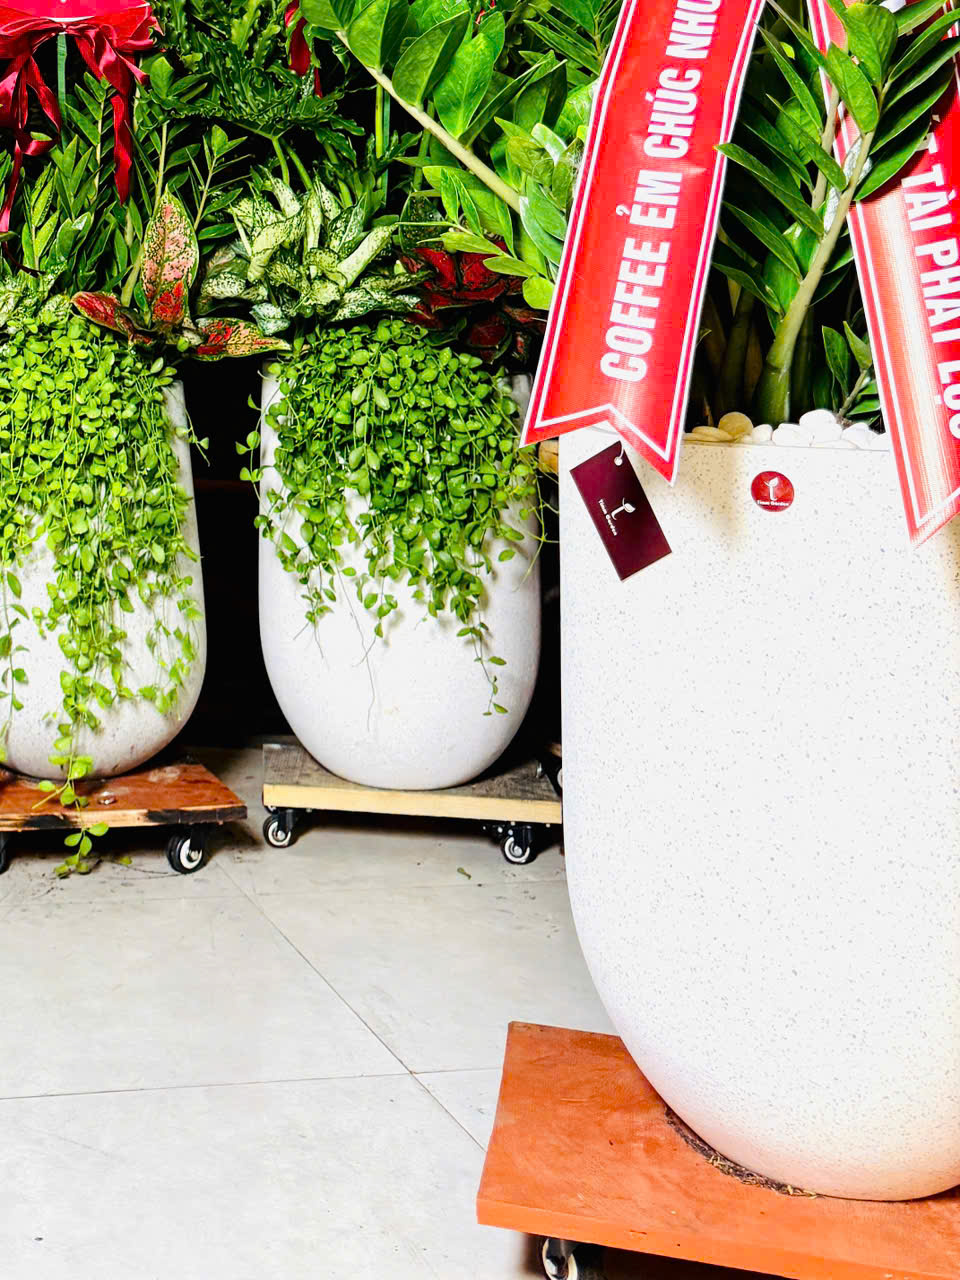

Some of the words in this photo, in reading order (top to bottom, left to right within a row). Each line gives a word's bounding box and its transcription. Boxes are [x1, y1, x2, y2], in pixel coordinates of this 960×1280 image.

[599, 237, 671, 383] COFFEE
[642, 68, 701, 159] CHÚC
[901, 163, 957, 233] TÀI
